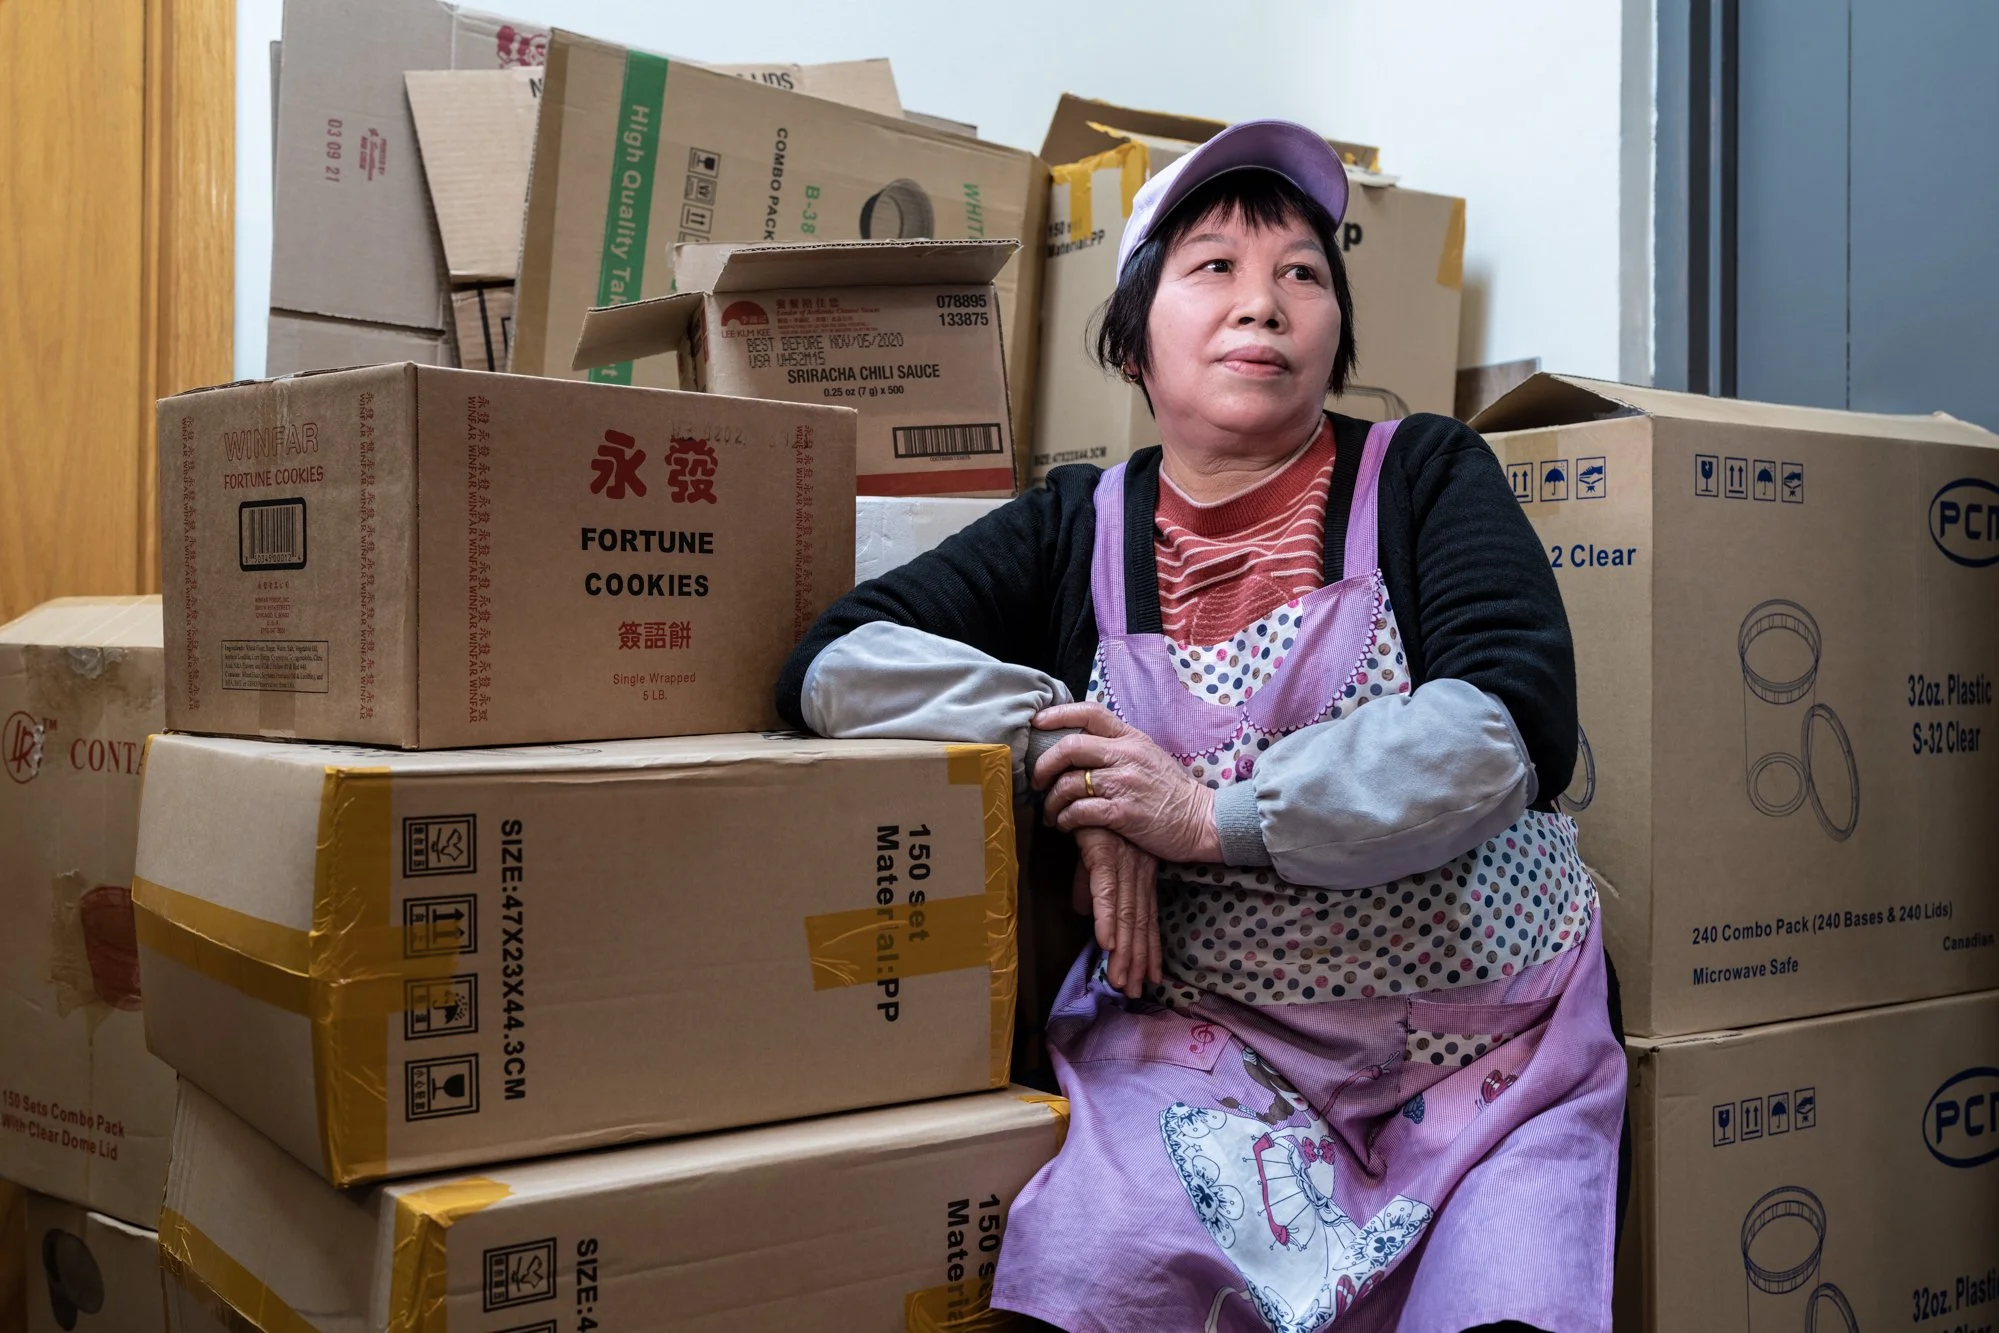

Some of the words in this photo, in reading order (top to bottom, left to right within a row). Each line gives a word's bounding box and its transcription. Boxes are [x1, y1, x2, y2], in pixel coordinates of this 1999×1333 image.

[326, 118, 343, 137] 03
[623, 104, 650, 163] High
[326, 142, 342, 160] 09
[770, 127, 789, 192] COMBO
[324, 165, 340, 183] 21
[610, 169, 642, 260] Quality
[763, 195, 780, 241] PACK
[800, 185, 821, 234] B-38
[963, 184, 984, 240] WHIT
[936, 294, 987, 309] 078895
[939, 312, 989, 326] 133875
[721, 329, 736, 339] LEE
[737, 329, 756, 338] KUM
[757, 328, 772, 337] KEE
[746, 338, 775, 353] BEST
[781, 335, 825, 352] BEFORE
[788, 367, 857, 384] SRIRACHA
[860, 365, 894, 381] CHILI
[897, 364, 941, 380] SAUCE
[823, 387, 843, 398] 0.25
[845, 388, 856, 397] oz
[858, 386, 866, 397] (7
[869, 386, 878, 397] g)
[887, 385, 904, 395] 500
[468, 396, 476, 441] WINFAR
[224, 422, 319, 461] WINFAR
[224, 470, 272, 490] FORTUNE
[275, 466, 324, 485] COOKIES
[468, 445, 477, 488] WINFAR
[590, 429, 719, 504] 永發
[468, 492, 477, 535] WINFAR
[468, 538, 477, 582] WINFAR
[581, 527, 714, 555] FORTUNE
[1570, 544, 1637, 568] Clear
[585, 572, 709, 597] COOKIES
[469, 585, 477, 629] WINFAR
[469, 632, 478, 676] WINFAR
[469, 679, 478, 723] WINFAR
[613, 673, 645, 687] Single
[649, 672, 696, 686] Wrapped
[643, 690, 649, 701] 5
[652, 689, 668, 700] LB.
[1908, 675, 1945, 707] 32oz.
[1948, 673, 1993, 706] Plastic
[1913, 723, 1943, 755] S-32
[1946, 720, 1981, 754] Clear
[908, 824, 931, 880] 150
[876, 825, 900, 1022] Material:PP
[908, 890, 930, 942] set
[1692, 926, 1718, 945] 240
[1722, 921, 1773, 942] Combo
[1776, 916, 1810, 937] Pack
[1813, 912, 1840, 935] (240
[1844, 909, 1884, 928] Bases
[1887, 907, 1896, 923] &
[1899, 904, 1921, 923] 240
[1924, 901, 1953, 920] Lids)
[501, 819, 526, 1101] SIZE:47X23X44.3CM
[1943, 932, 1995, 952] Canadian
[1693, 962, 1767, 985] Microwave
[1770, 956, 1799, 975] Safe
[23, 1095, 48, 1117] Sets
[51, 1103, 94, 1129] Combo
[97, 1114, 125, 1138] Pack
[28, 1121, 60, 1144] Clear
[62, 1129, 97, 1155] Dome
[99, 1140, 118, 1161] Lid
[978, 1193, 1001, 1253] 150
[947, 1198, 970, 1322] Materia
[1913, 1286, 1952, 1323] 32oz.
[1955, 1266, 1999, 1311] Plasti
